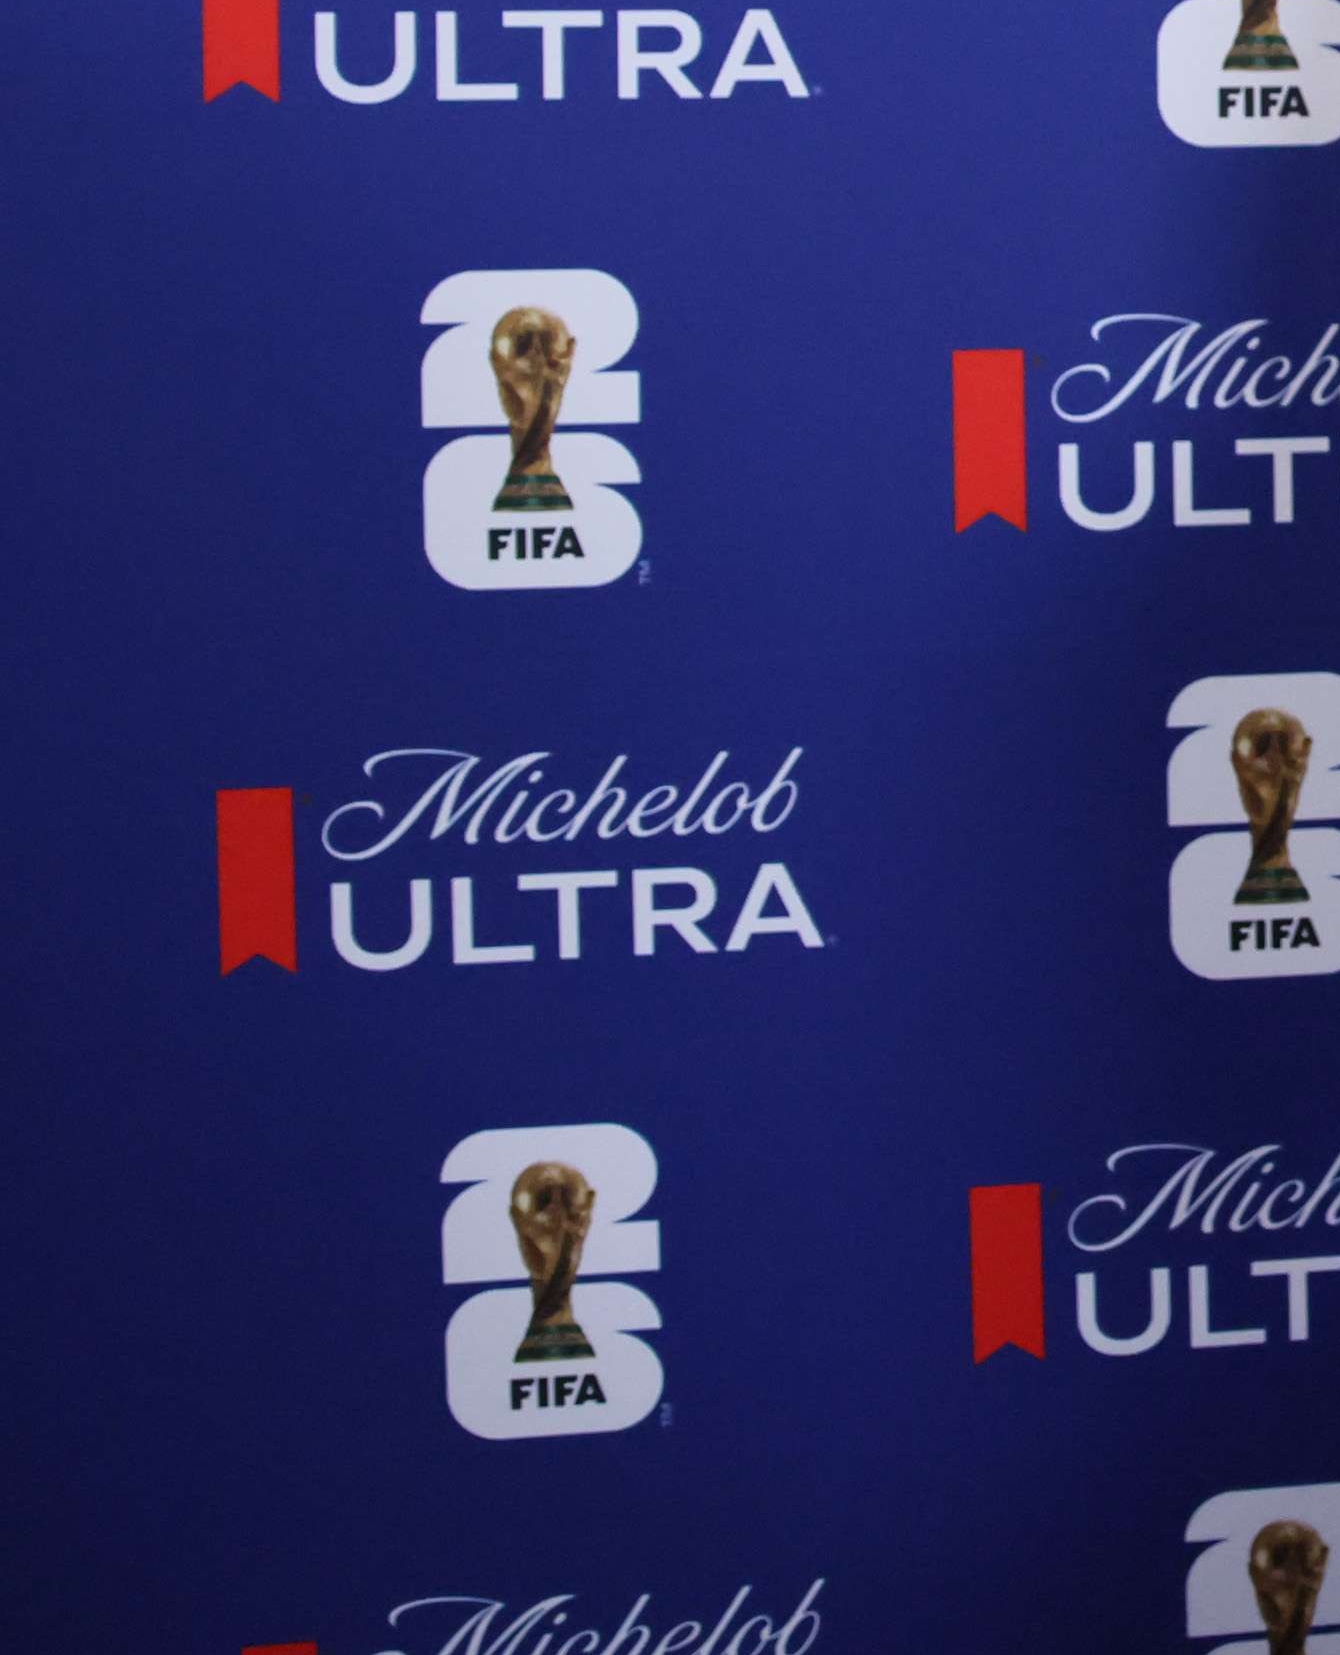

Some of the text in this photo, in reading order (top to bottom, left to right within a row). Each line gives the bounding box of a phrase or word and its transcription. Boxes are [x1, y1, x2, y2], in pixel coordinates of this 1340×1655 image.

[314, 9, 810, 104] ULTRA
[1219, 86, 1309, 118] FIFA
[488, 526, 585, 560] FIFA
[321, 746, 803, 861] Michelob
[330, 863, 824, 971] ULTRA
[1230, 917, 1320, 951] FIFA
[510, 1373, 606, 1410] FIFA
